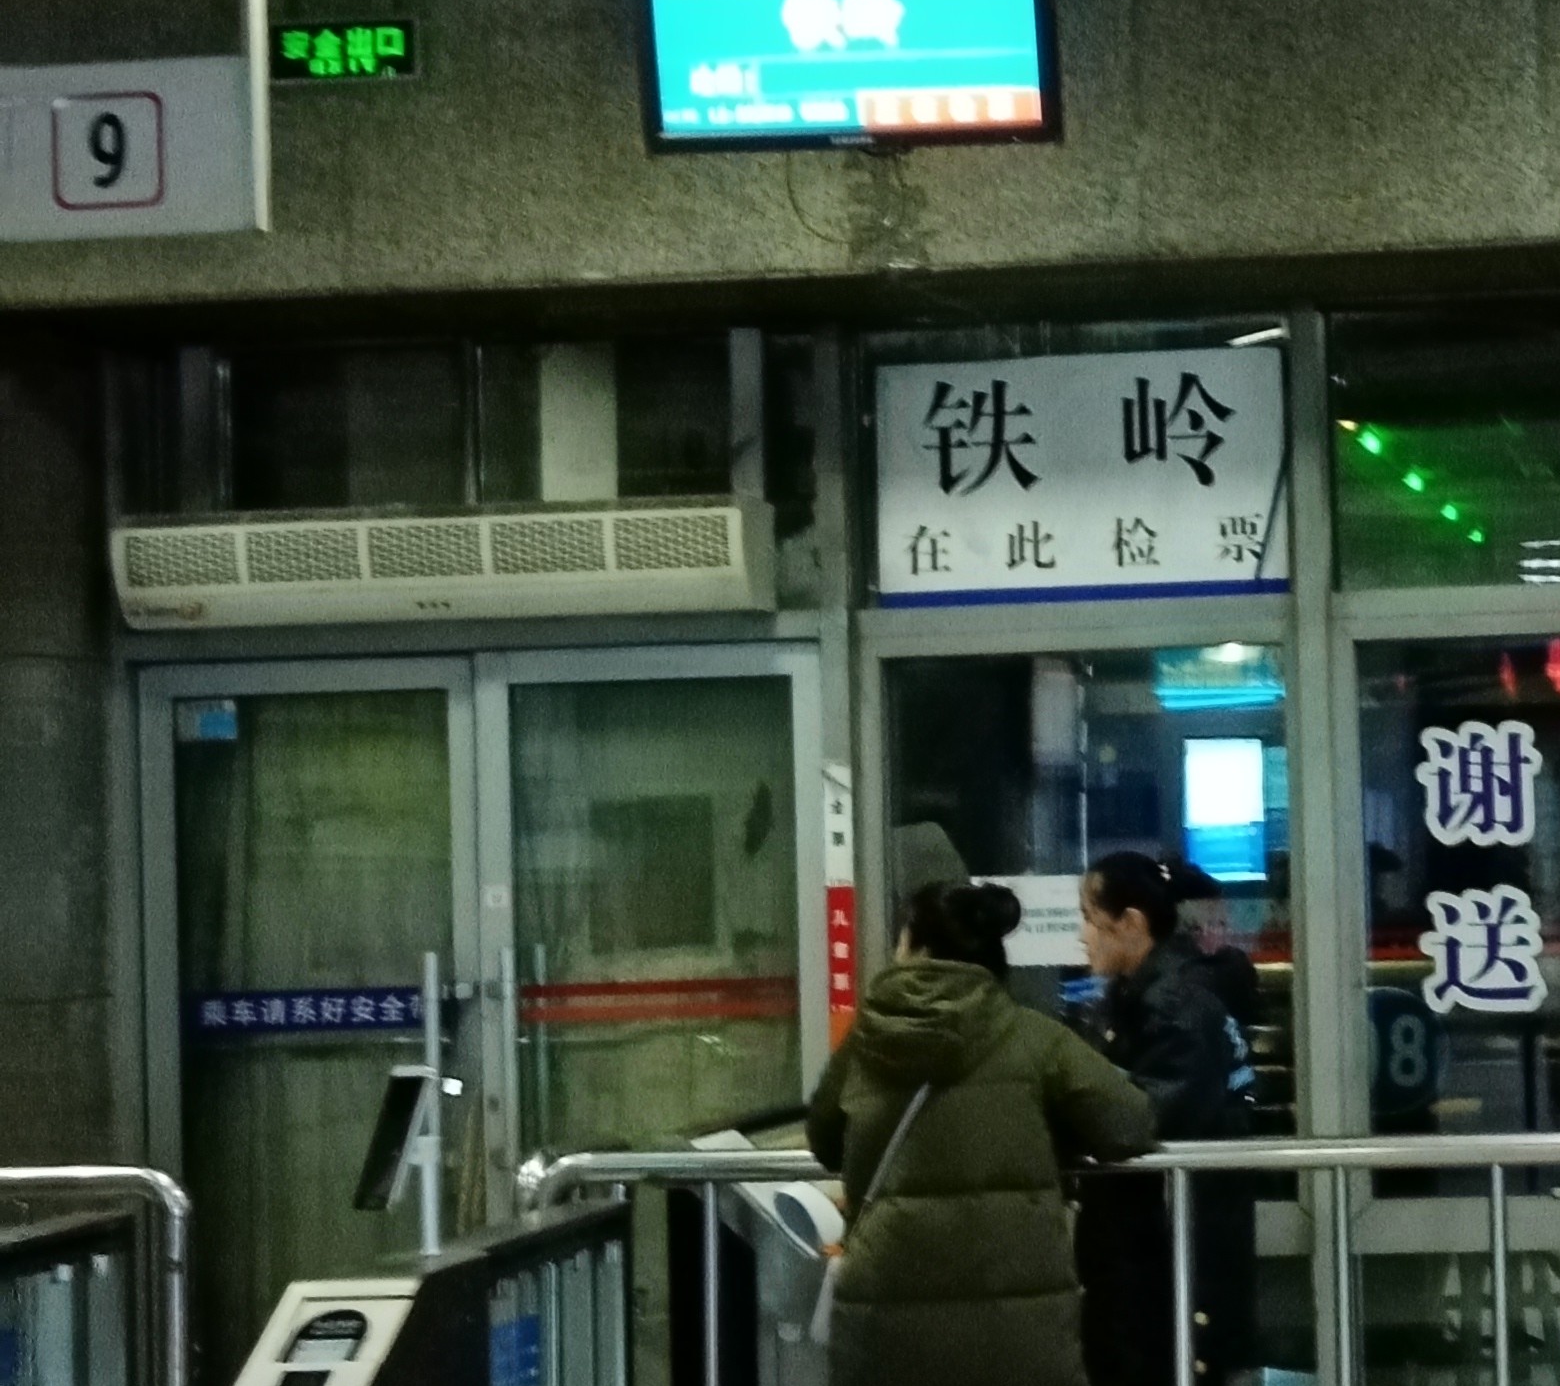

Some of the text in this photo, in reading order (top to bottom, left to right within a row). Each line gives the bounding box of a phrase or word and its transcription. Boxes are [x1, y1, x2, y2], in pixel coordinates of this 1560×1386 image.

[88, 111, 126, 189] 9
[921, 371, 1237, 497] 铁岭
[905, 513, 1267, 577] 在此检票
